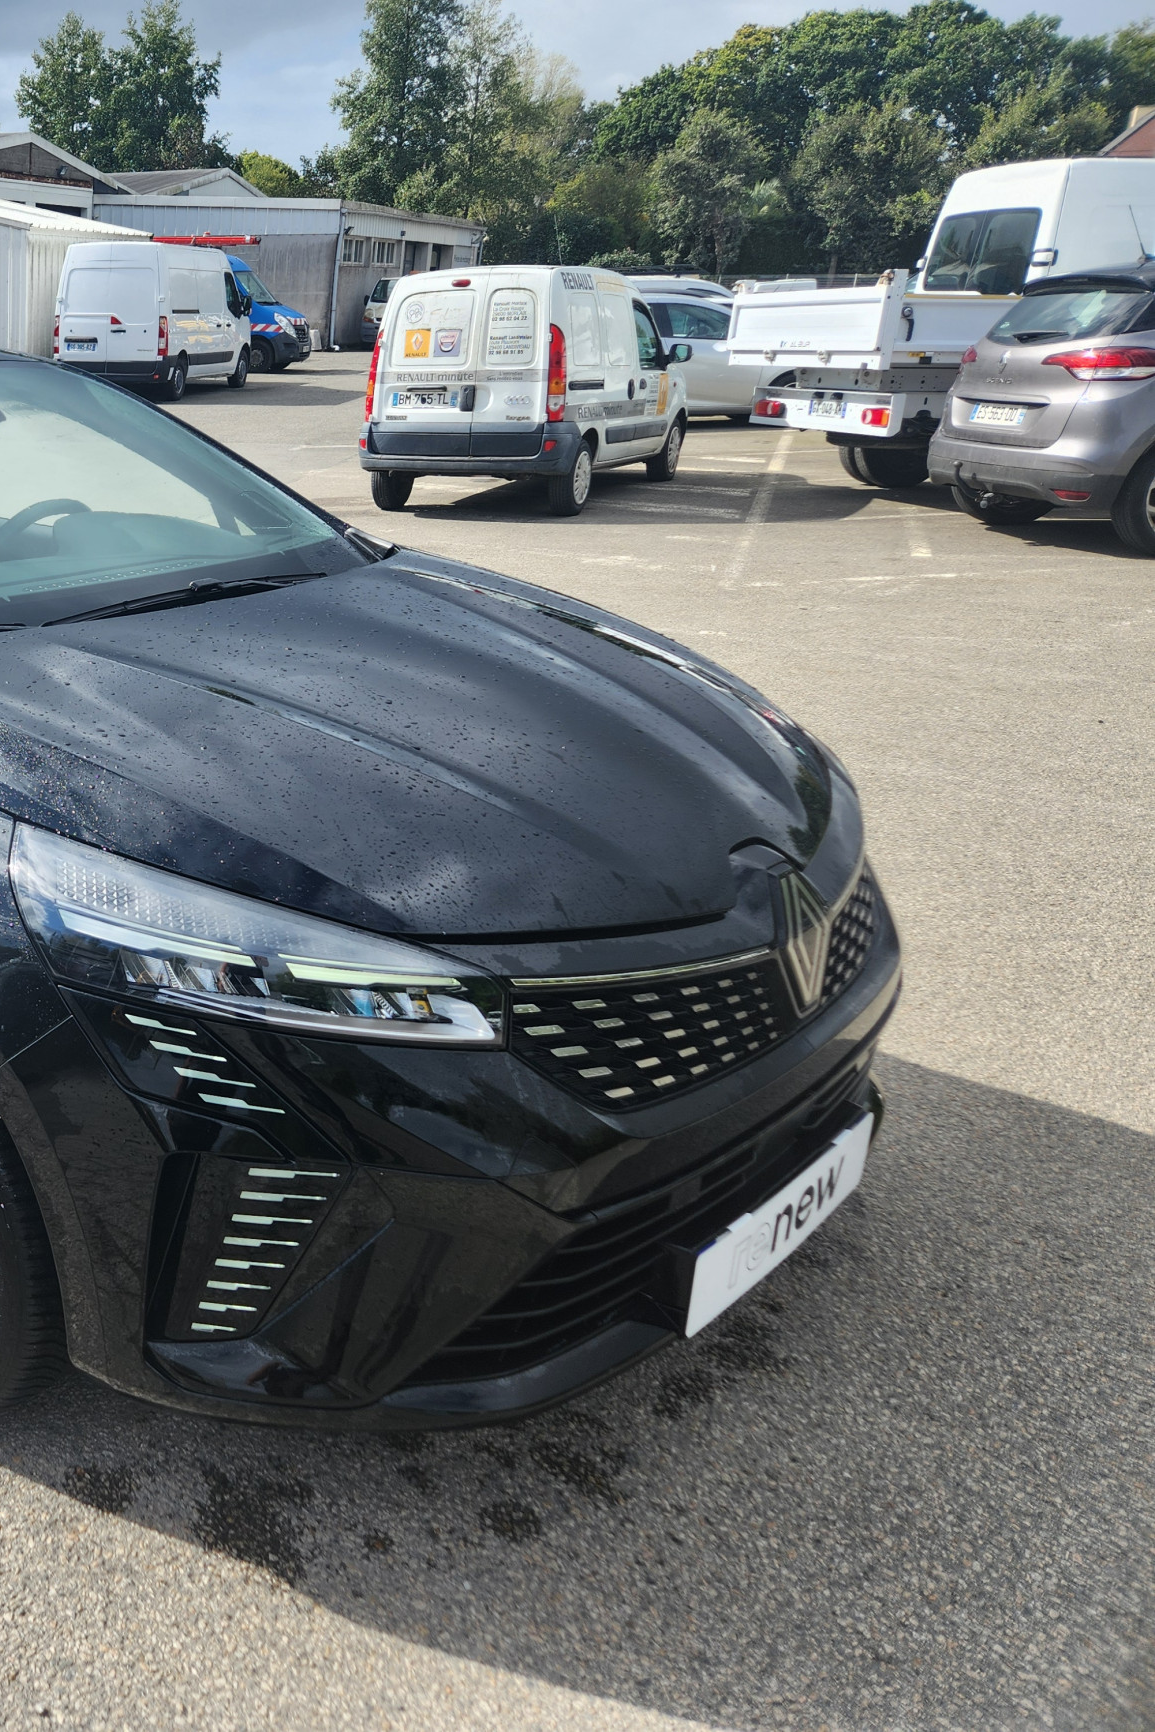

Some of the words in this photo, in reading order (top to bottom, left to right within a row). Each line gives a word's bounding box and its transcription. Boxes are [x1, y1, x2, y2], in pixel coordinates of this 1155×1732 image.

[561, 272, 594, 290] RENAULT
[397, 373, 435, 382] RENAULT
[727, 1155, 845, 1290] renew
